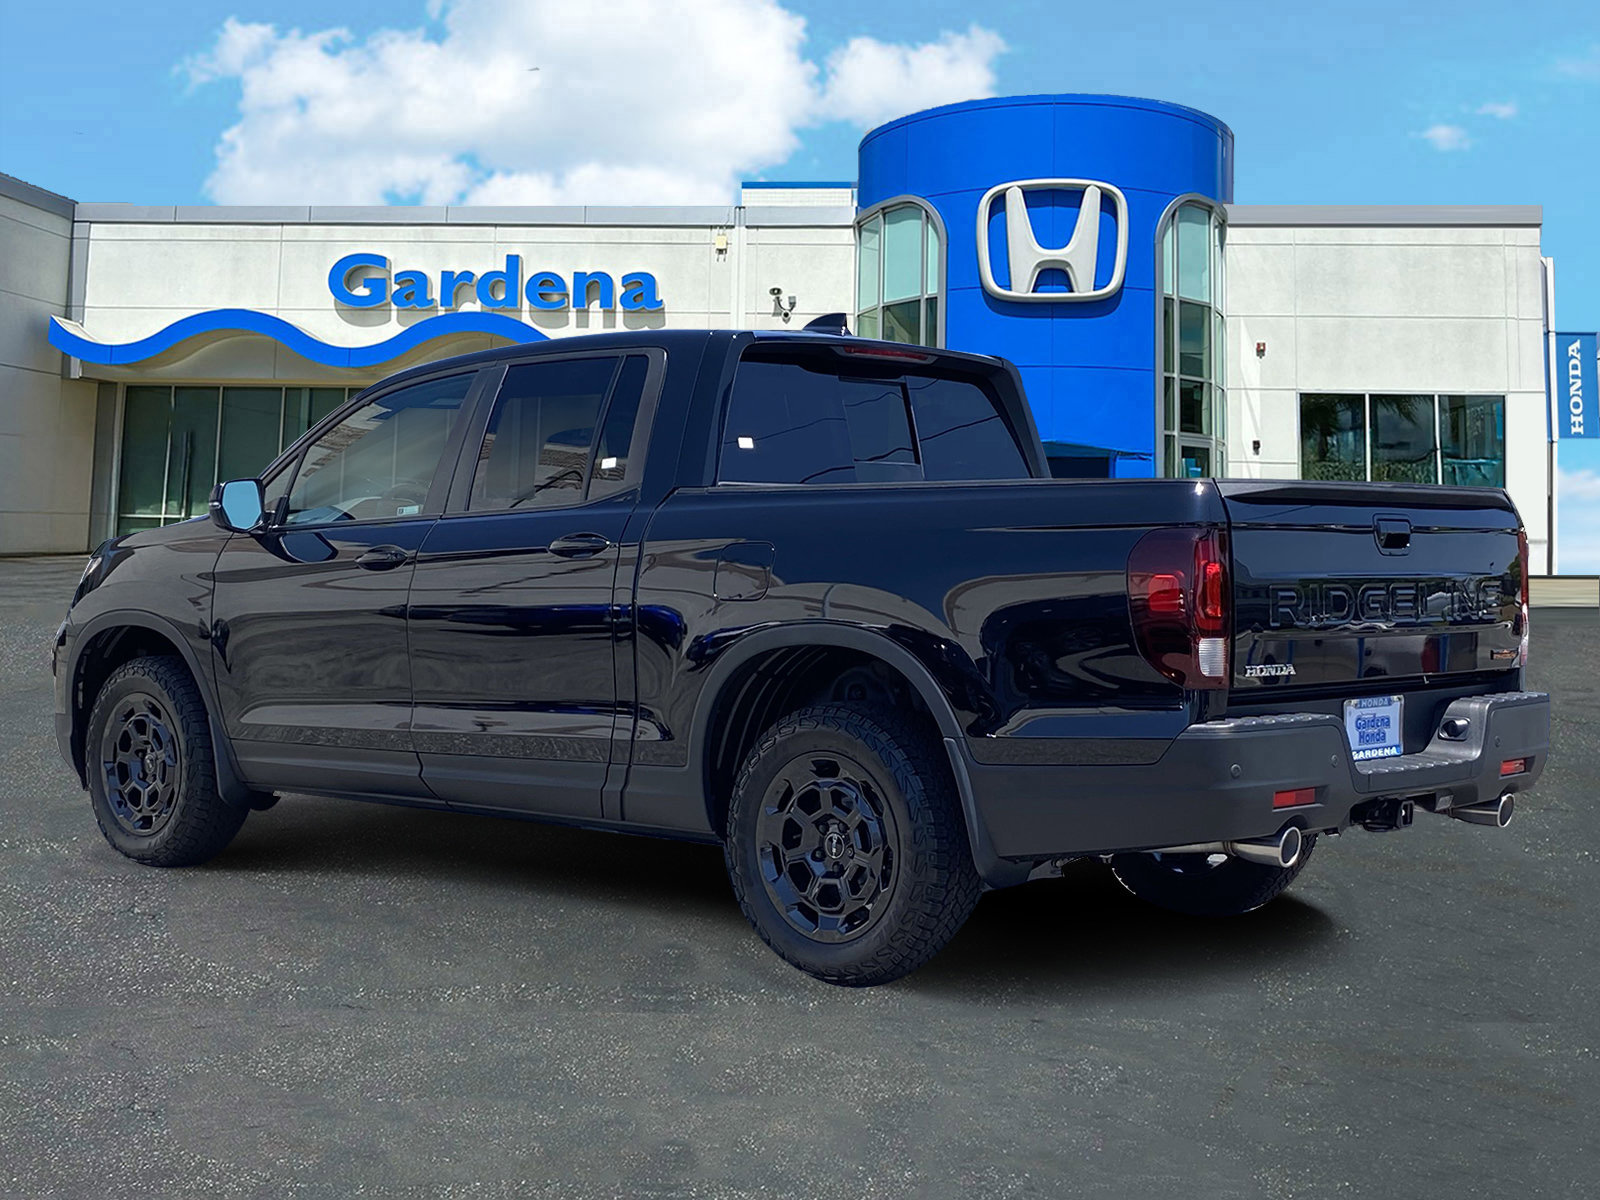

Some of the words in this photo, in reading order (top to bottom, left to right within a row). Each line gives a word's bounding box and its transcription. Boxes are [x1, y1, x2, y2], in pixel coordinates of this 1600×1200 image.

[328, 253, 664, 309] Gardena
[1568, 339, 1584, 435] HONDA
[1269, 580, 1502, 627] RIDGELINE
[1245, 663, 1297, 678] HONDA
[1361, 698, 1389, 707] HONDA
[1355, 714, 1391, 730] Gardena
[1358, 729, 1387, 745] Honda
[1352, 746, 1397, 760] GARDENA
